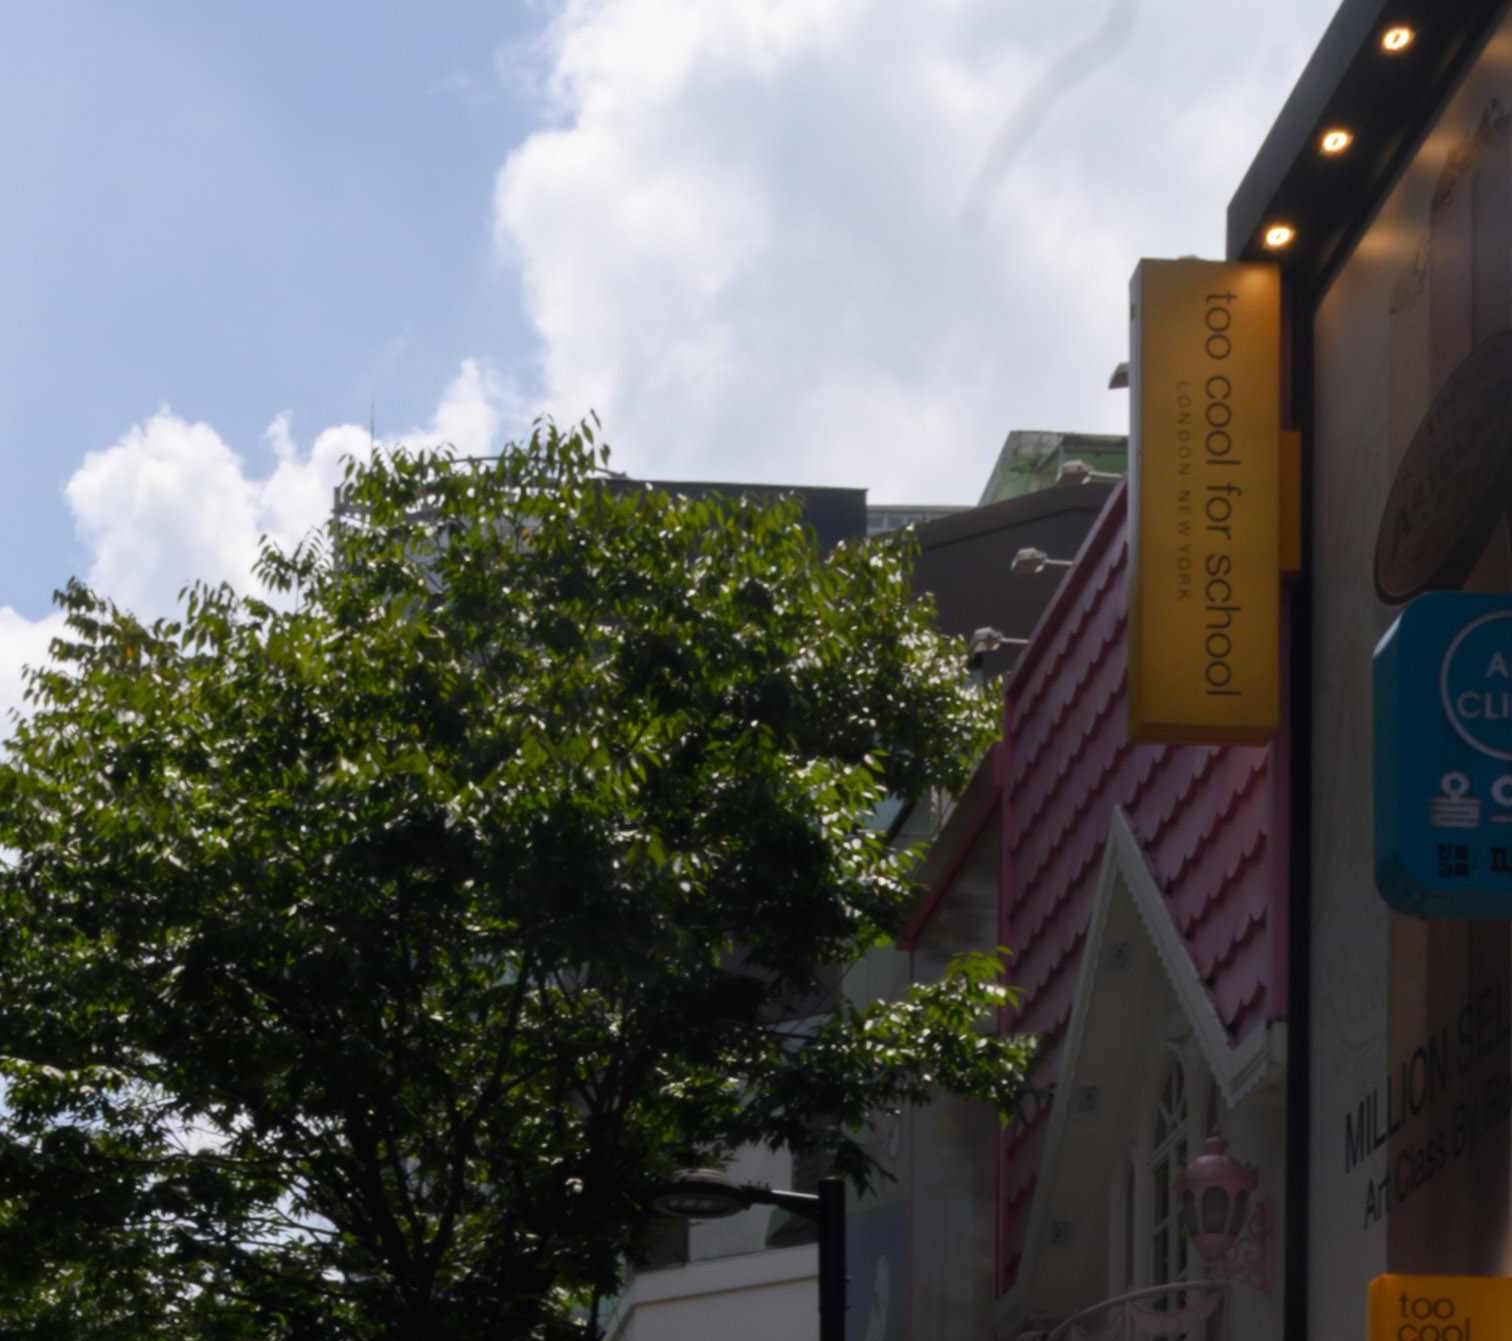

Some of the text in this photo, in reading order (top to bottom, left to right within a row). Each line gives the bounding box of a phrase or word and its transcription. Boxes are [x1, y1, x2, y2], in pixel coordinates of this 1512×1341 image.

[1205, 291, 1242, 697] too cool for school
[1399, 1290, 1455, 1321] too
